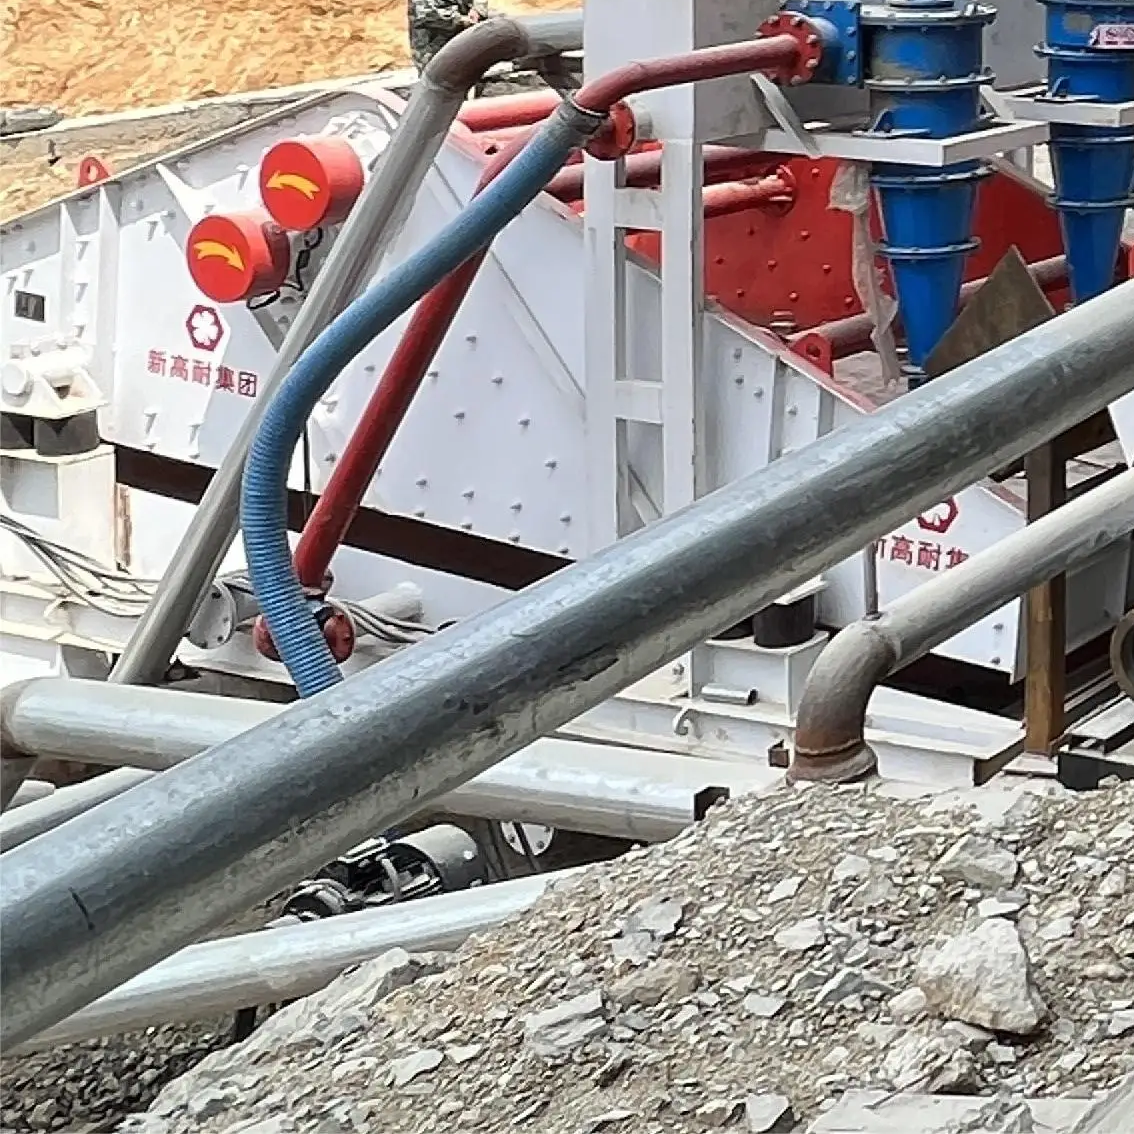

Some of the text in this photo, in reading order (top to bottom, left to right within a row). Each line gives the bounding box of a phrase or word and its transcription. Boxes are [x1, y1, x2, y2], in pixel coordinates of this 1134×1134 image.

[148, 350, 257, 397] 新高耐集团
